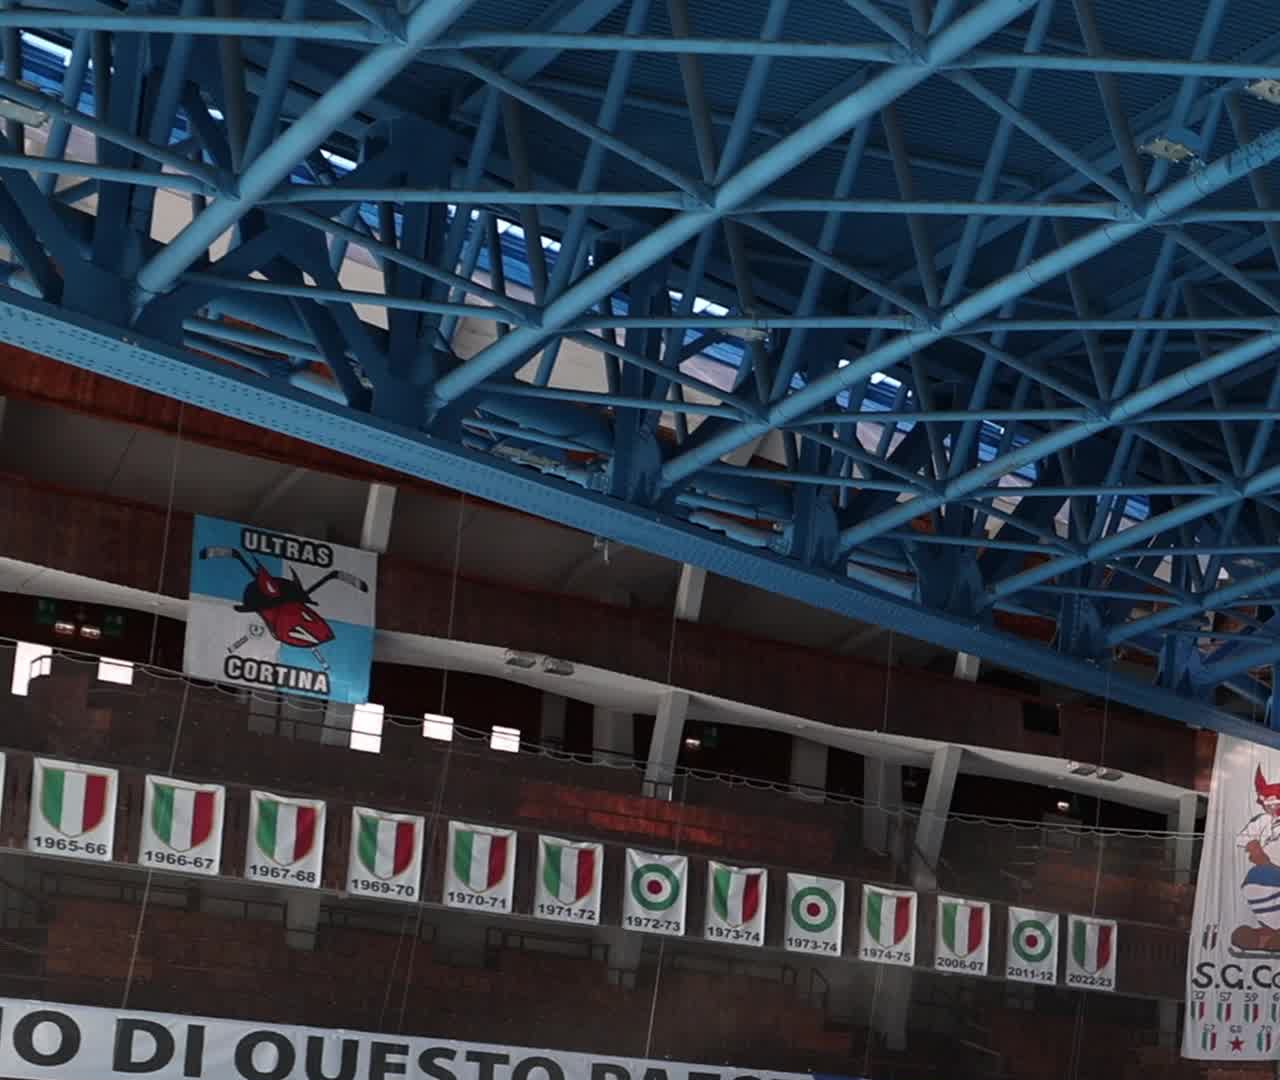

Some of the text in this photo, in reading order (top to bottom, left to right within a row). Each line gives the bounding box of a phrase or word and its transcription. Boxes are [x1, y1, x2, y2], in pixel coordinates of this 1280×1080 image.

[244, 530, 331, 566] ULTRAS
[227, 656, 328, 693] CORTINA
[33, 836, 107, 856] 1965-66
[144, 850, 214, 870] 1966-67
[250, 864, 316, 883] 1967-68
[351, 878, 414, 897] 1969-70
[448, 891, 507, 909] 1970-71
[538, 903, 595, 921] 1971-72
[626, 915, 681, 932] 1972-73
[707, 926, 761, 942] 1973-74
[786, 937, 838, 952] 1973-74
[1008, 966, 1053, 981] 2011-12
[0, 1006, 81, 1067] O
[112, 1018, 205, 1078] DI
